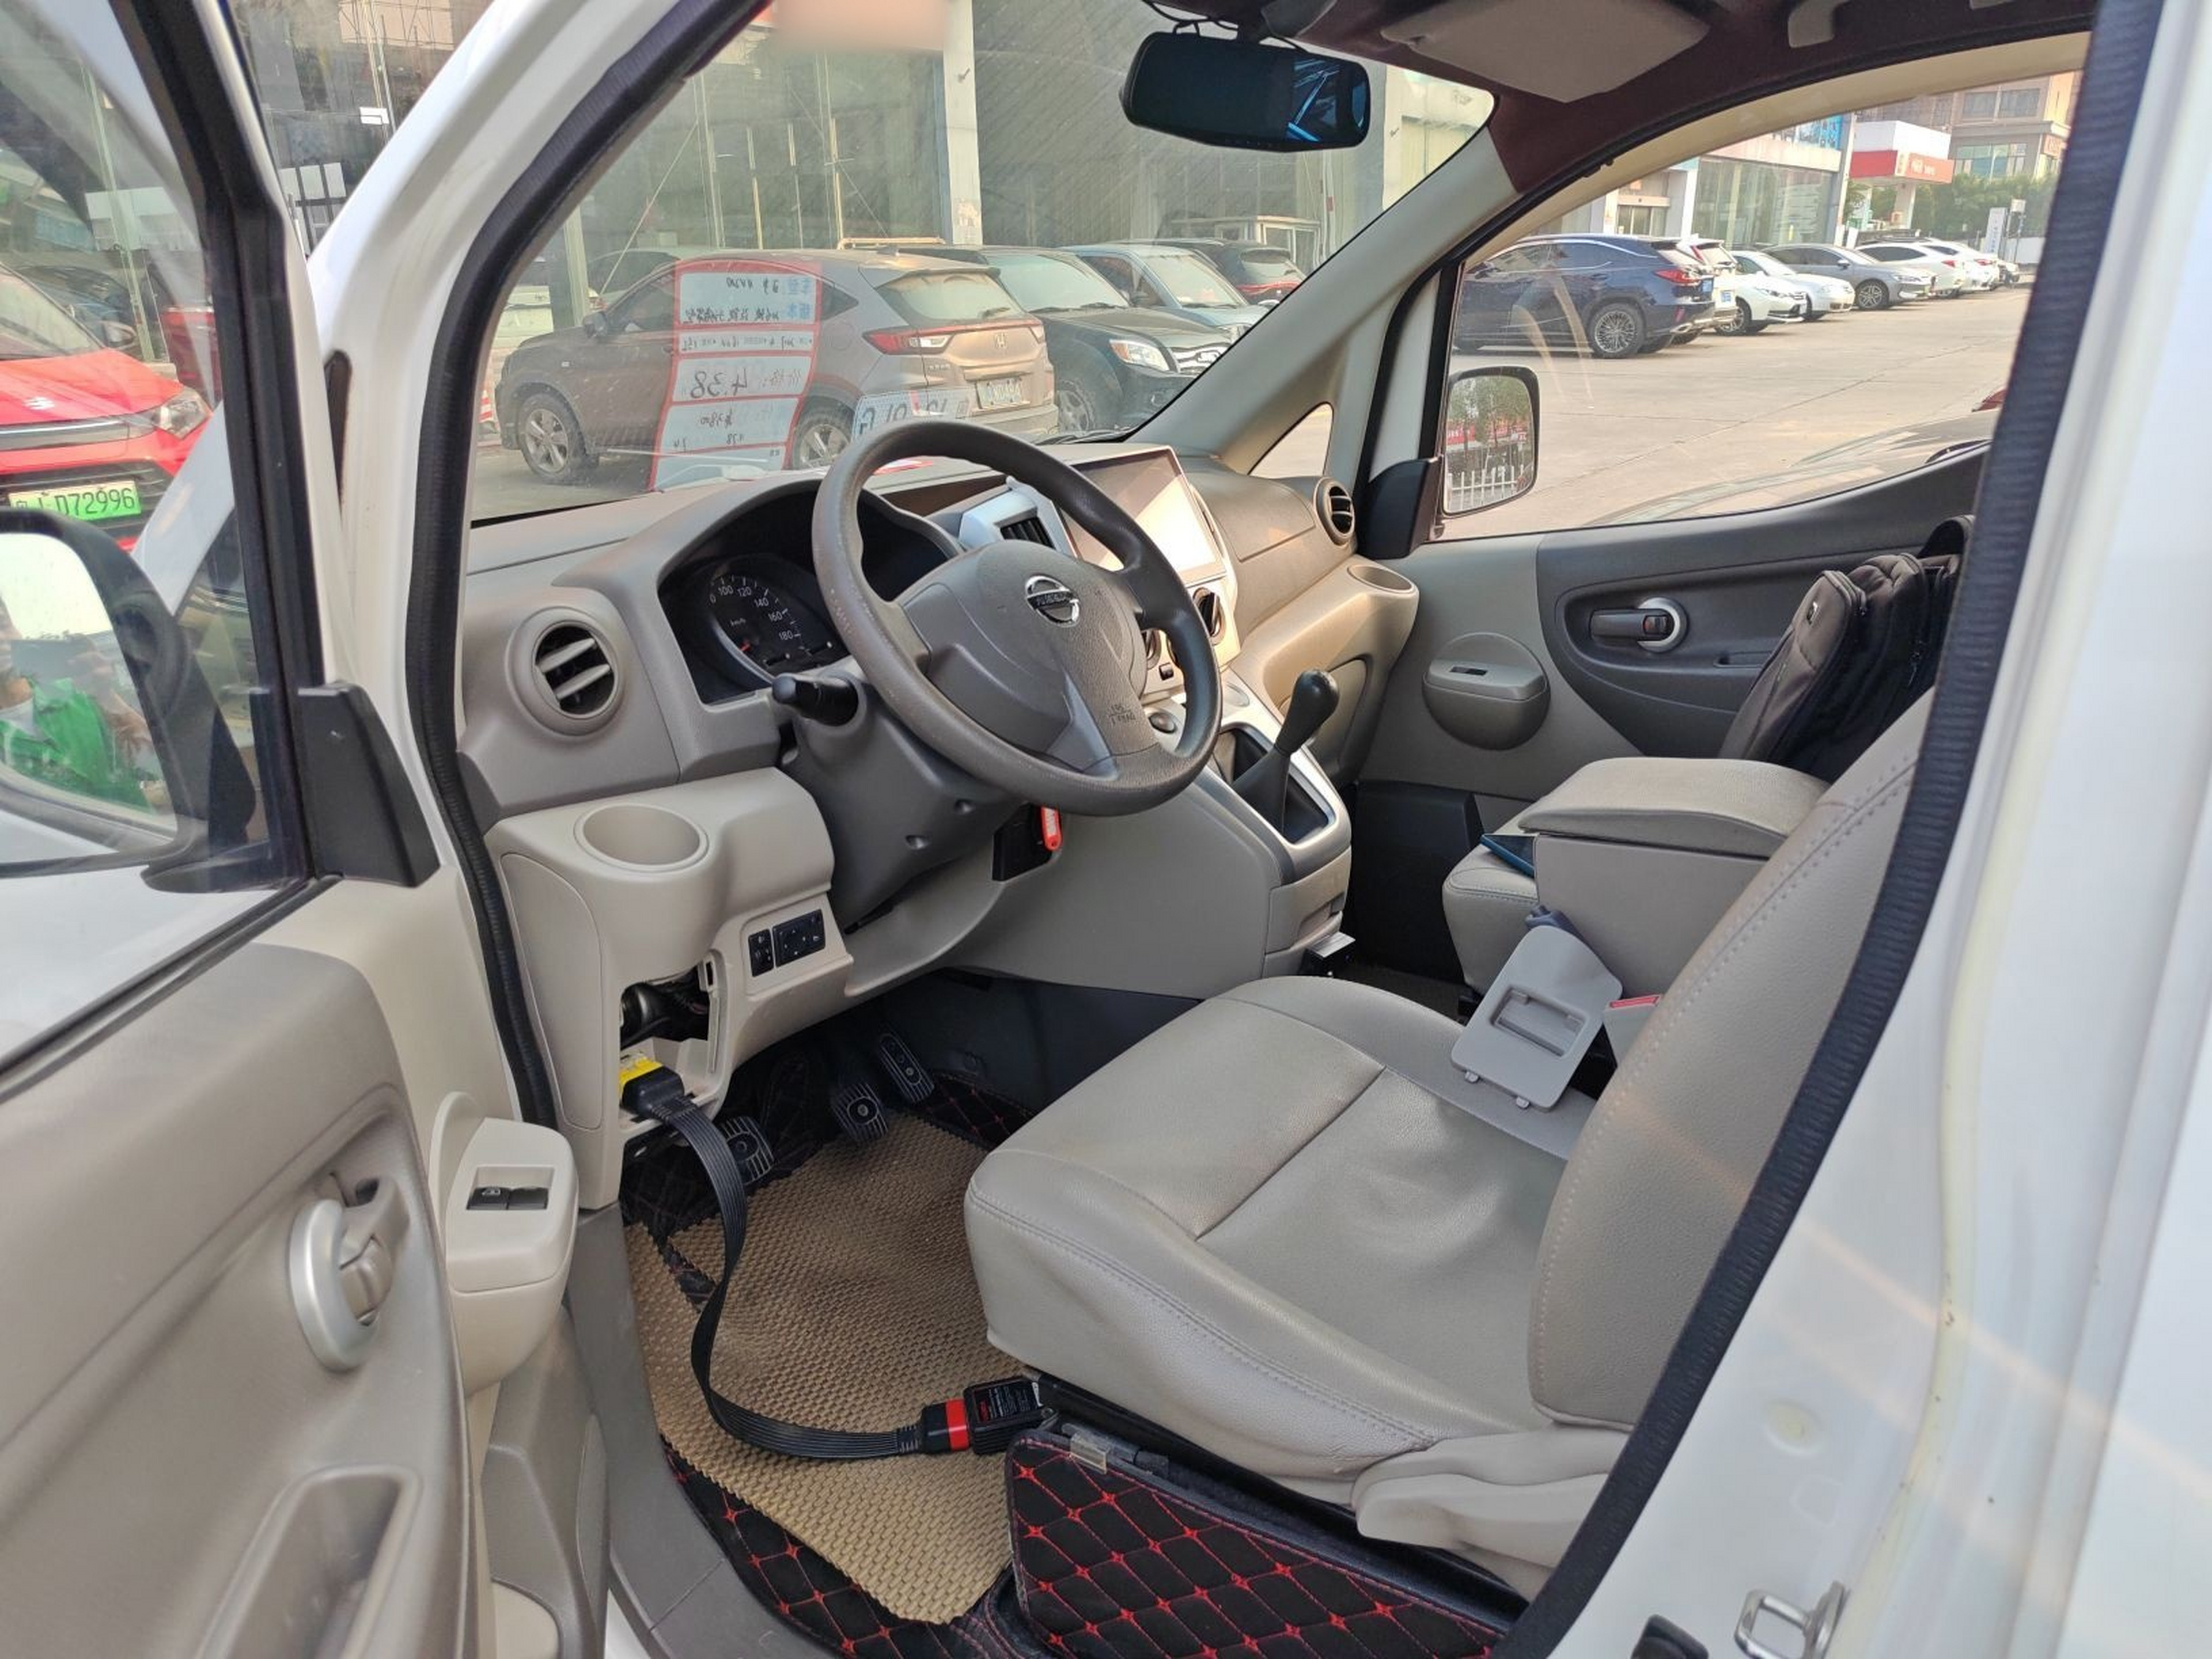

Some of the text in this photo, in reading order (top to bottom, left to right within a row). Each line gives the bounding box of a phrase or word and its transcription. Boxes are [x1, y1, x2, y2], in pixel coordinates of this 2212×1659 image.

[718, 586, 733, 596] 100
[737, 586, 752, 597] 120
[754, 597, 769, 608] 140
[768, 612, 783, 622] 160
[779, 630, 793, 640] 180
